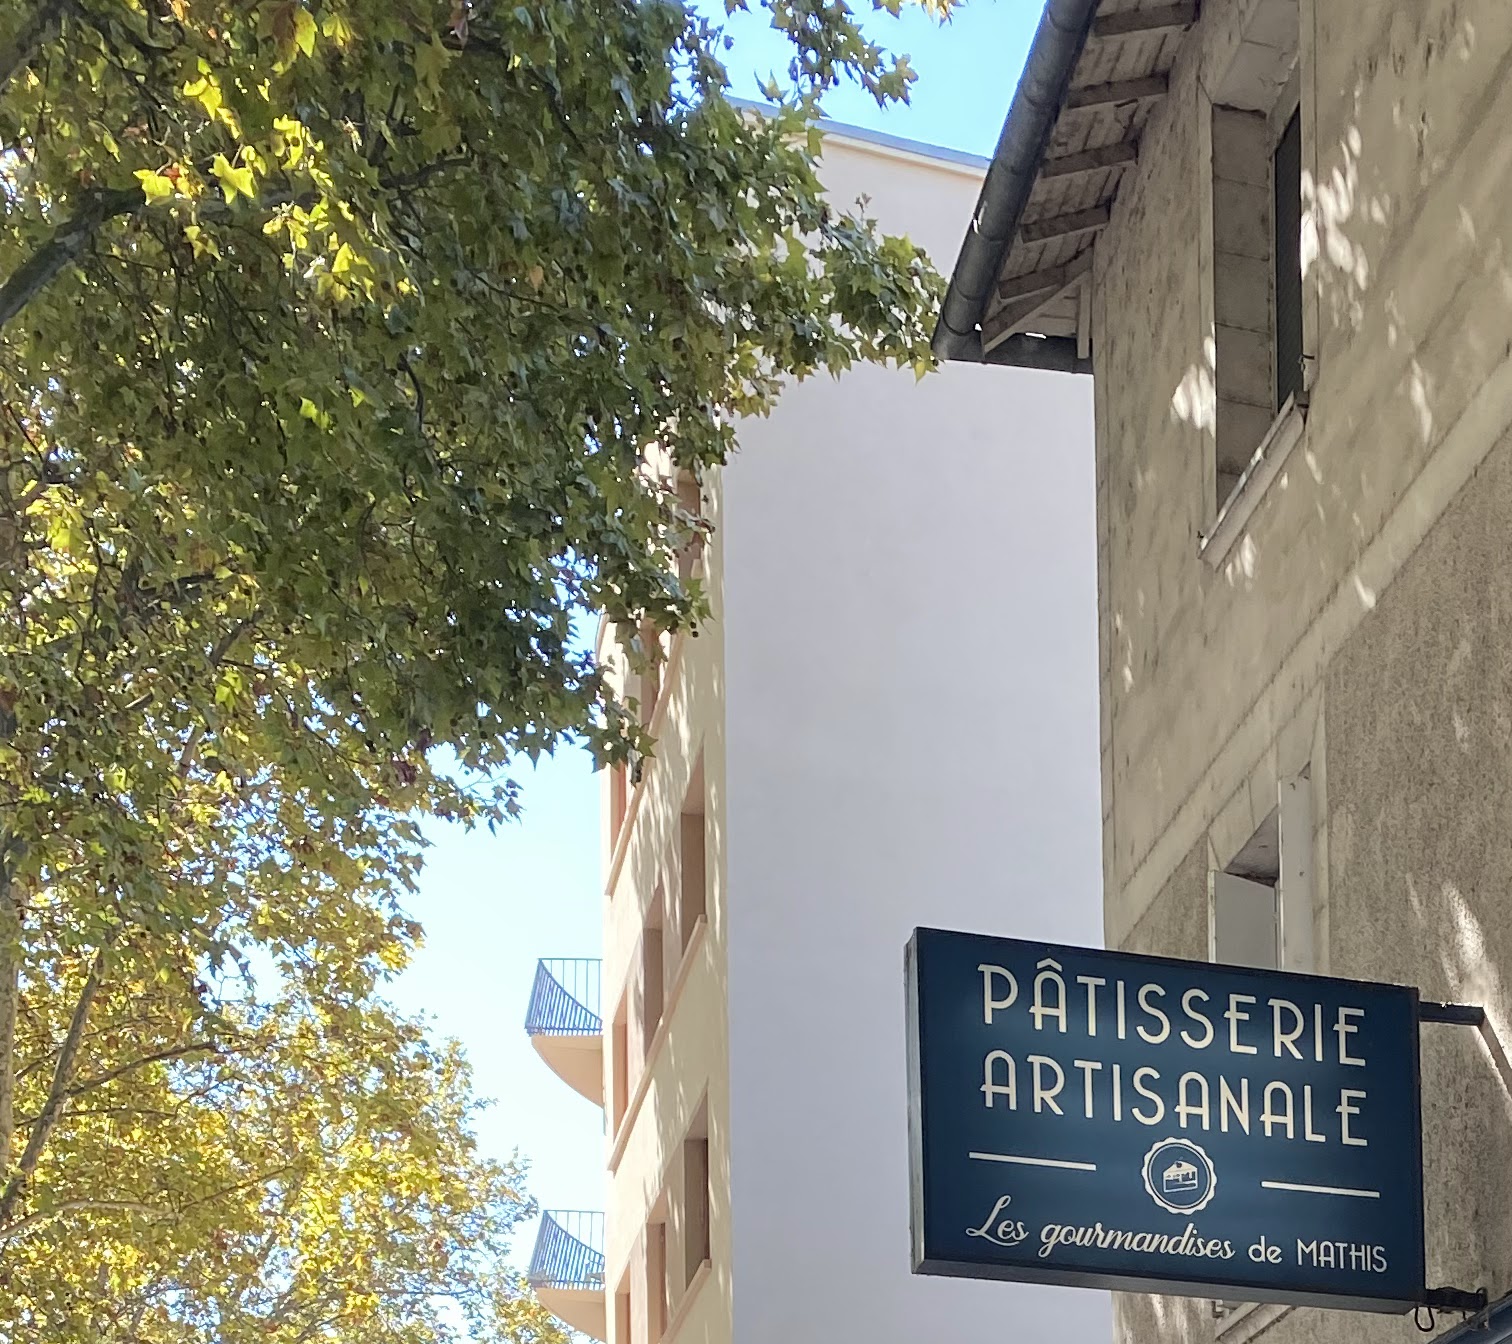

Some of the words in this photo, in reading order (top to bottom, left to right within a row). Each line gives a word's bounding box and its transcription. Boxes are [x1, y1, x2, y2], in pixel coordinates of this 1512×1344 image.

[977, 957, 1366, 1068] PÂTISSERIE
[979, 1048, 1368, 1147] ARTISANALE
[965, 1194, 1030, 1247] Les
[1037, 1222, 1236, 1260] gourmandises
[1247, 1235, 1283, 1265] de
[1296, 1237, 1389, 1274] MATHIS
